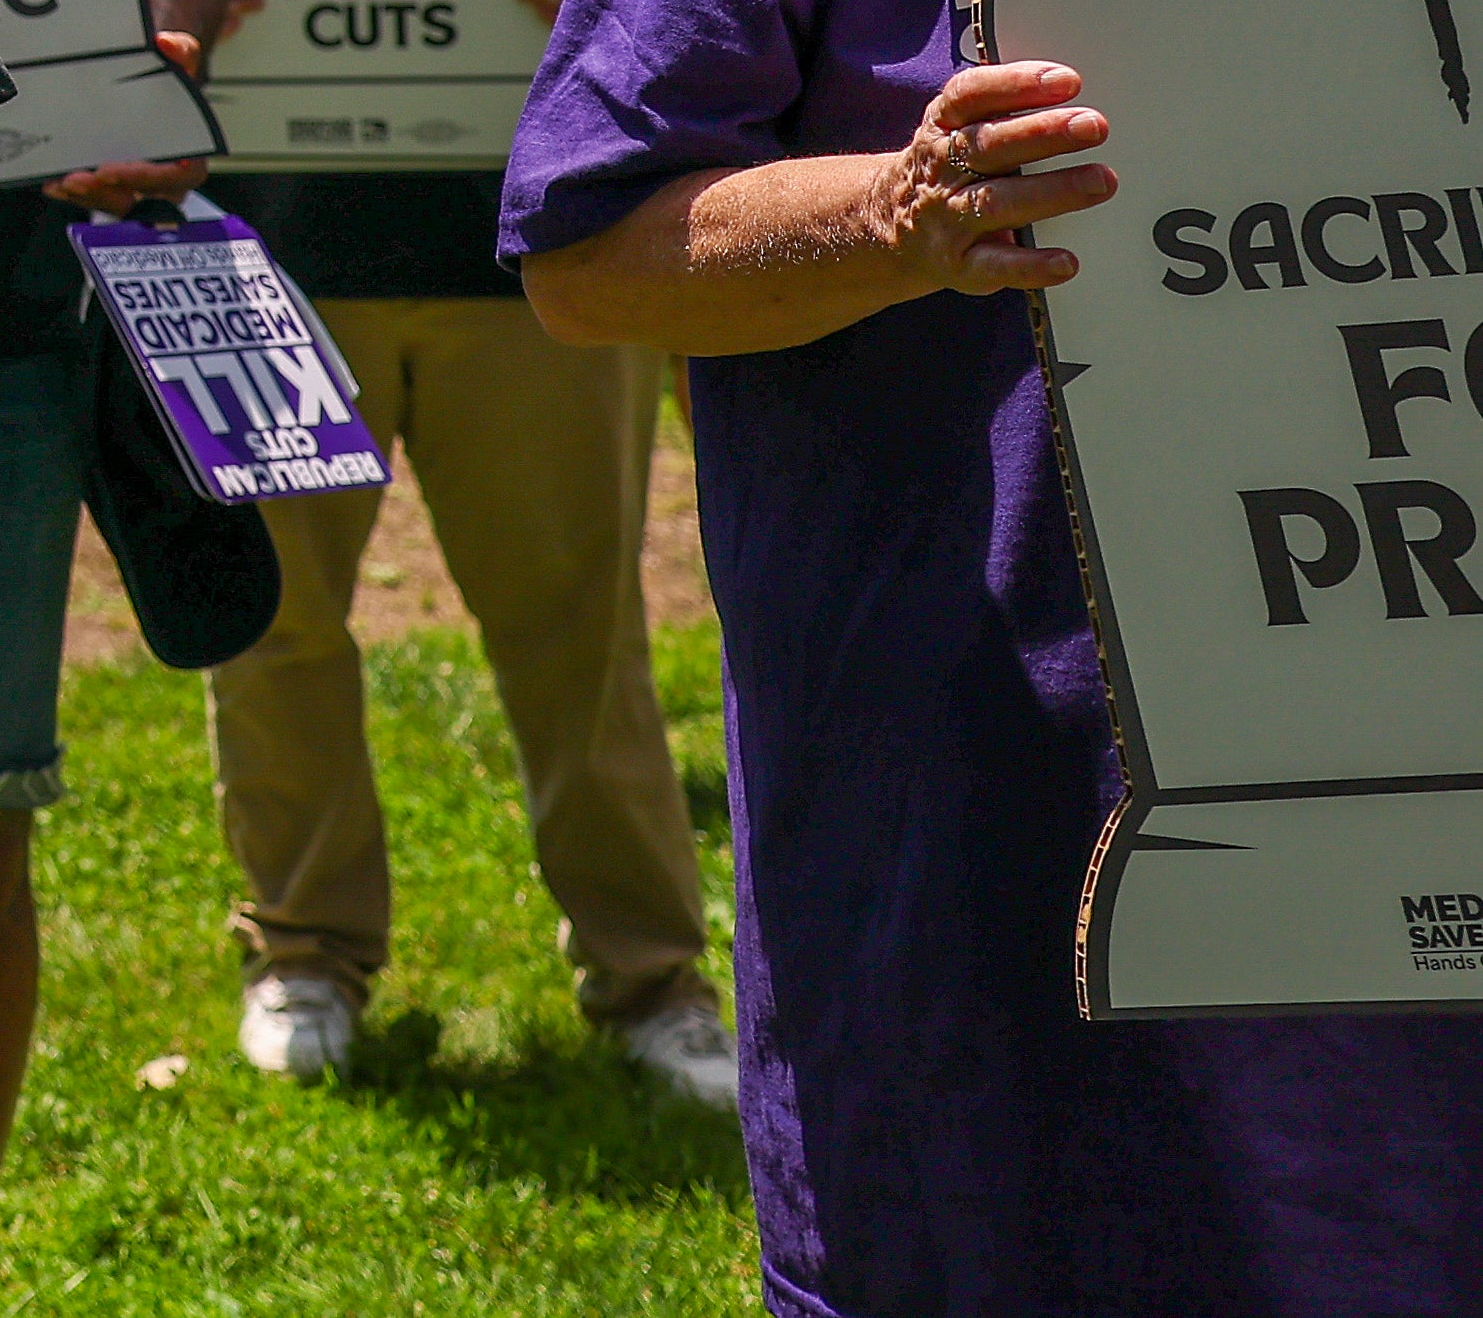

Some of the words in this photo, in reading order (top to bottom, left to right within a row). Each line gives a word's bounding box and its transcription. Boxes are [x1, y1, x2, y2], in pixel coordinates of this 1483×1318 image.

[305, 2, 456, 48] CUTS
[114, 279, 198, 310] LIVES
[197, 274, 281, 305] SAVES
[134, 306, 303, 350] MEDICAID
[149, 344, 352, 436] KILL
[1335, 318, 1483, 460] F
[244, 426, 319, 462] CUTS
[211, 450, 387, 498] REPUBLICAN
[1400, 893, 1483, 923] MED
[1408, 924, 1483, 949] SAVE
[1413, 954, 1477, 971] Hands
